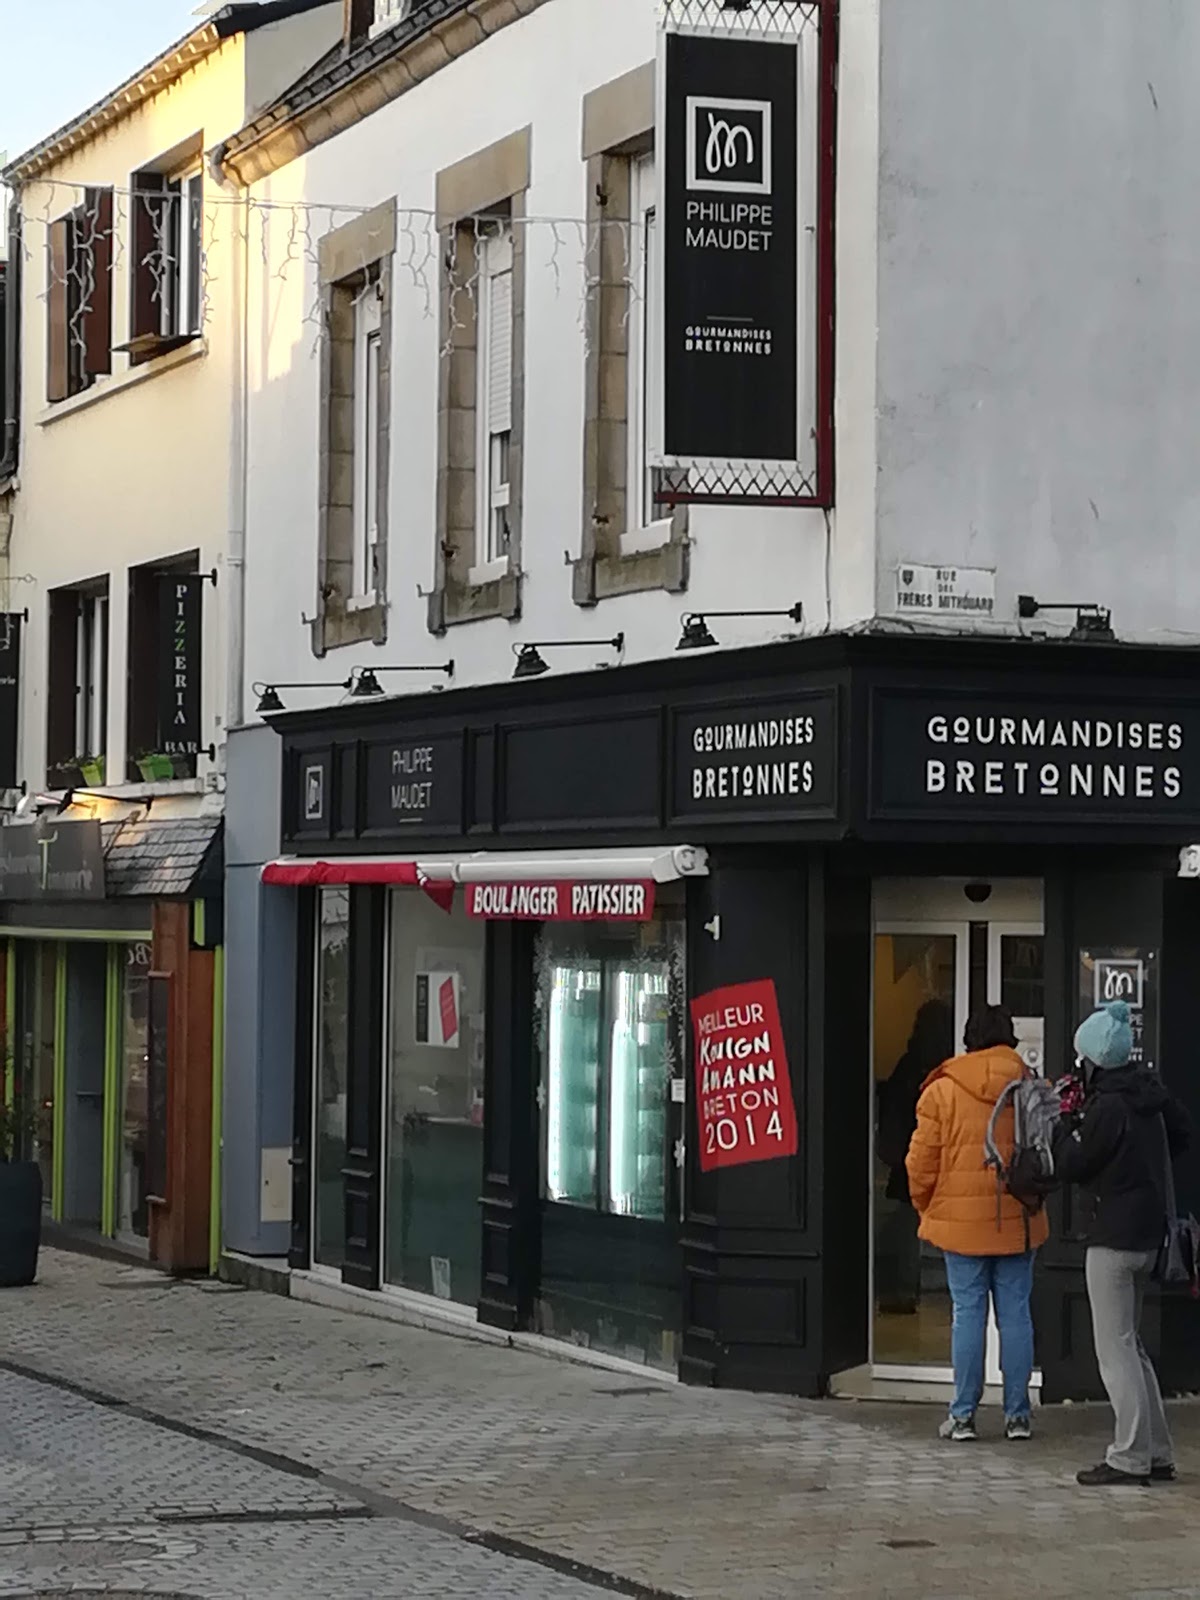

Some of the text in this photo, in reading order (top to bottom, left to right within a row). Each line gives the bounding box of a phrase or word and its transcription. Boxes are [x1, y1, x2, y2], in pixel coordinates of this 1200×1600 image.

[686, 201, 773, 226] PHILIPPE
[685, 227, 773, 251] MAUDET
[685, 326, 772, 340] GOURMANDISES
[685, 339, 772, 354] BRETONNES
[936, 570, 956, 582] RUE
[174, 584, 188, 725] PIZZERIA
[164, 741, 198, 754] BAR
[693, 716, 814, 752] GOURMANDISES
[927, 716, 1183, 750] GOURMANDISES
[391, 747, 434, 774] PHILIPPE
[692, 760, 813, 799] BRETONNES
[926, 760, 1181, 798] BRETONNES
[391, 782, 433, 809] MAUDET
[473, 884, 645, 915] BOULANGER PATISSIER
[698, 1002, 765, 1037] MEILLEUR
[702, 1058, 776, 1095] AMANN
[703, 1086, 780, 1120] BRETON
[705, 1109, 784, 1154] 2014
